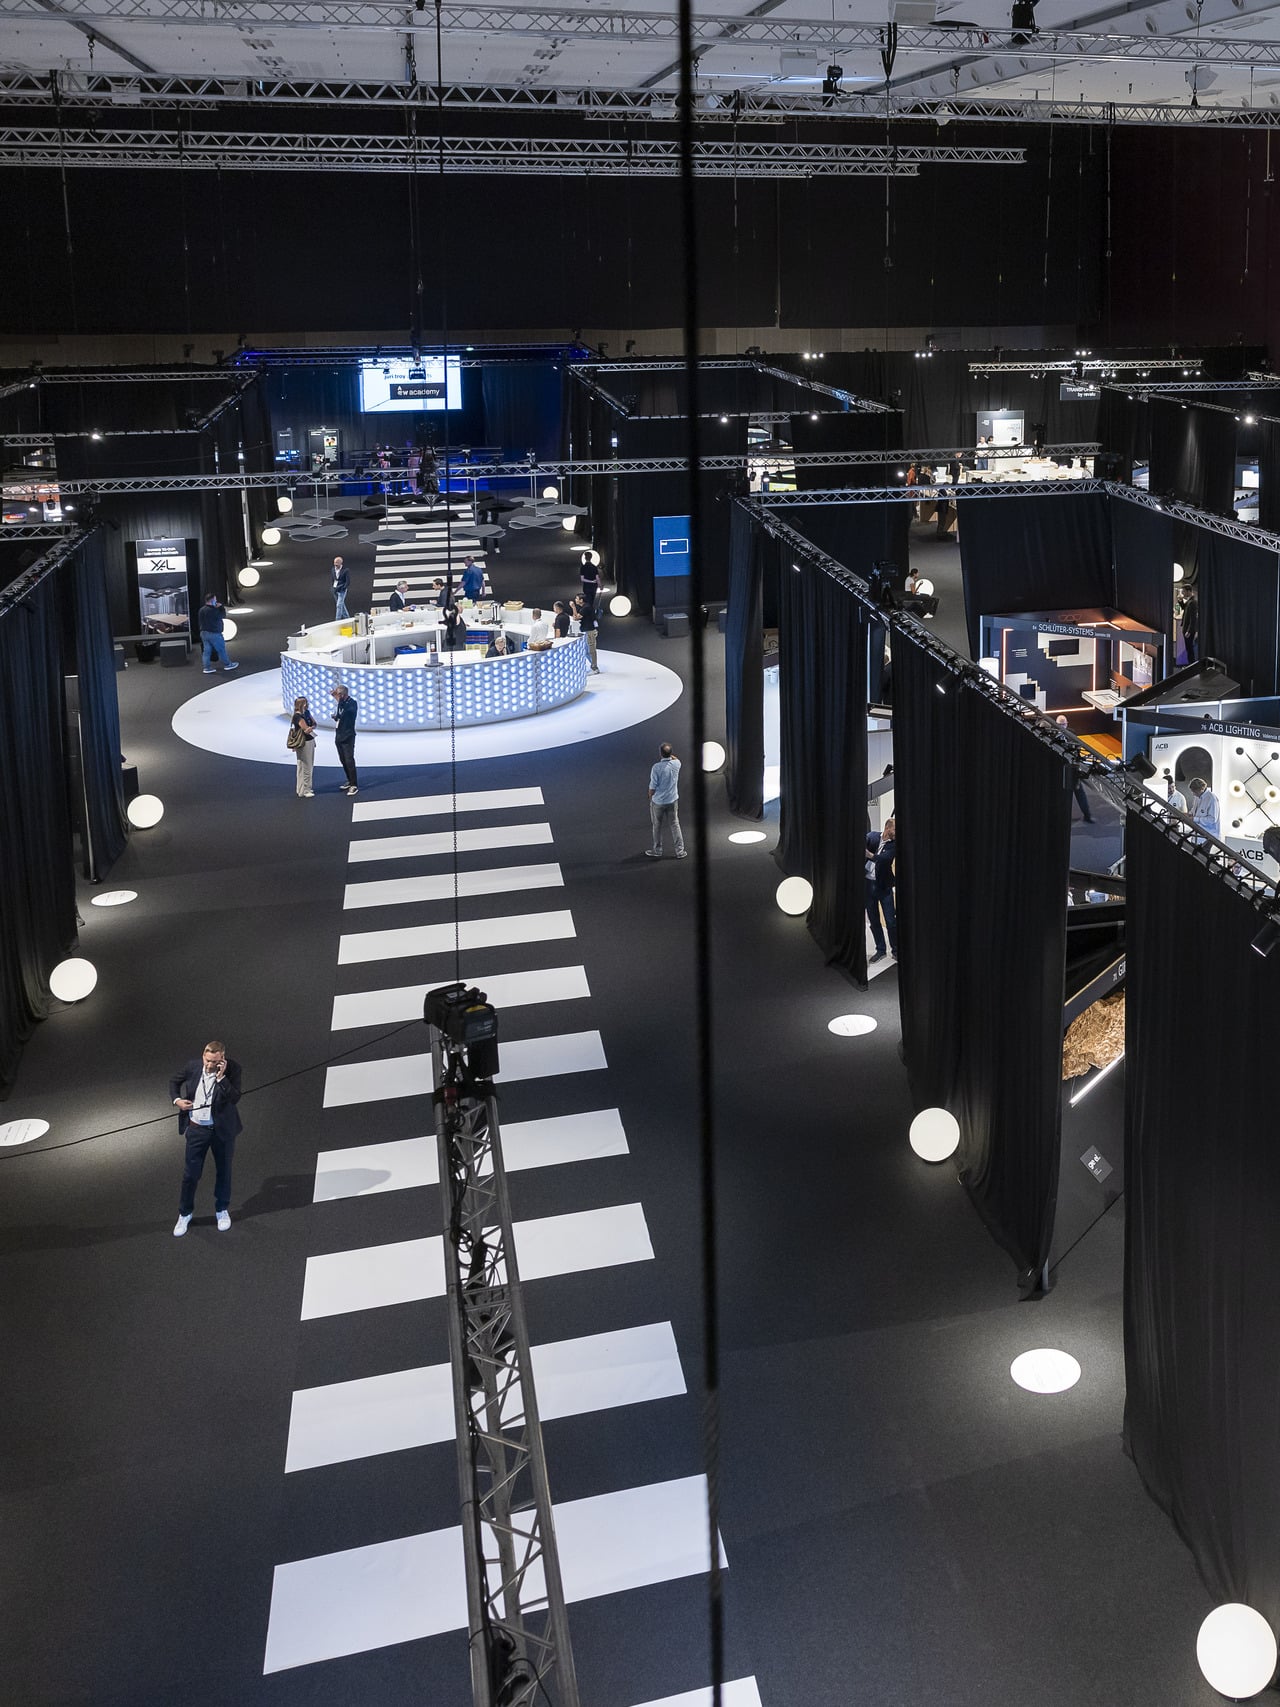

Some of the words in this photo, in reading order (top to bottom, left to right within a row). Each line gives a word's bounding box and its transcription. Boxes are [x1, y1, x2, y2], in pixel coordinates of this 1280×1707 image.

[151, 559, 176, 571] XAL
[1038, 623, 1094, 636] SCHLÜTER-SYSTEMS
[1208, 722, 1224, 733] ACB
[1225, 725, 1261, 738] LIGHTING
[1239, 848, 1264, 861] ACB
